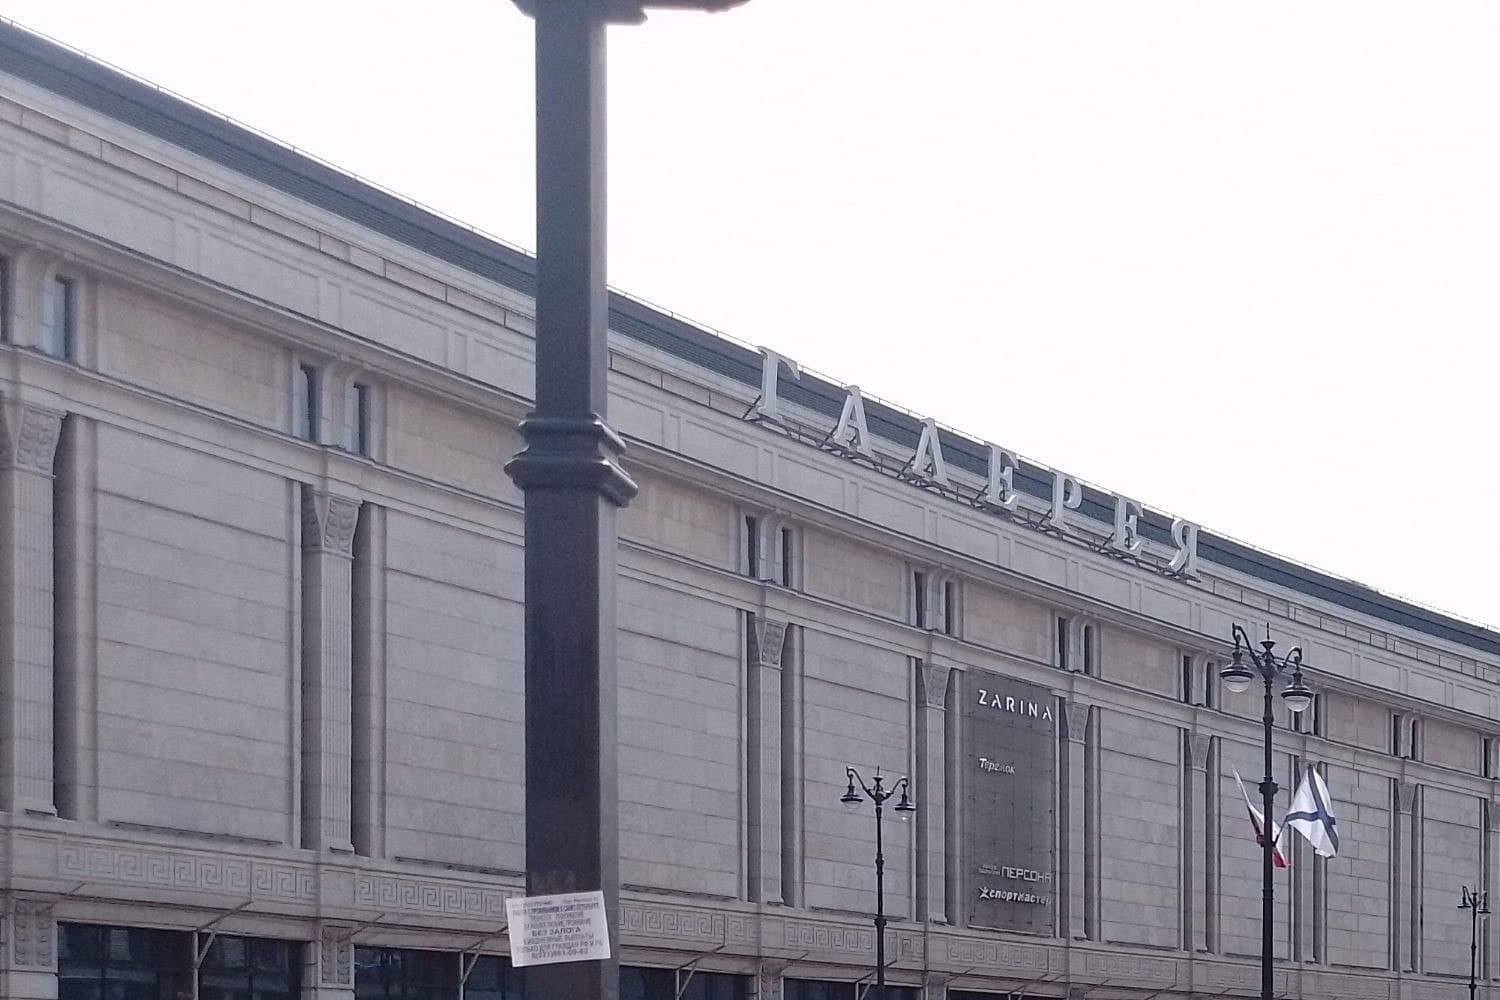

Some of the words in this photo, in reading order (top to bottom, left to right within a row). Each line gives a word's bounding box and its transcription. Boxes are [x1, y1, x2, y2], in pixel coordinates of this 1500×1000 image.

[757, 345, 1201, 583] ГАЛЕРЕЯ
[978, 689, 1052, 721] ZARINA
[1001, 866, 1051, 883] ПЕРСОНА
